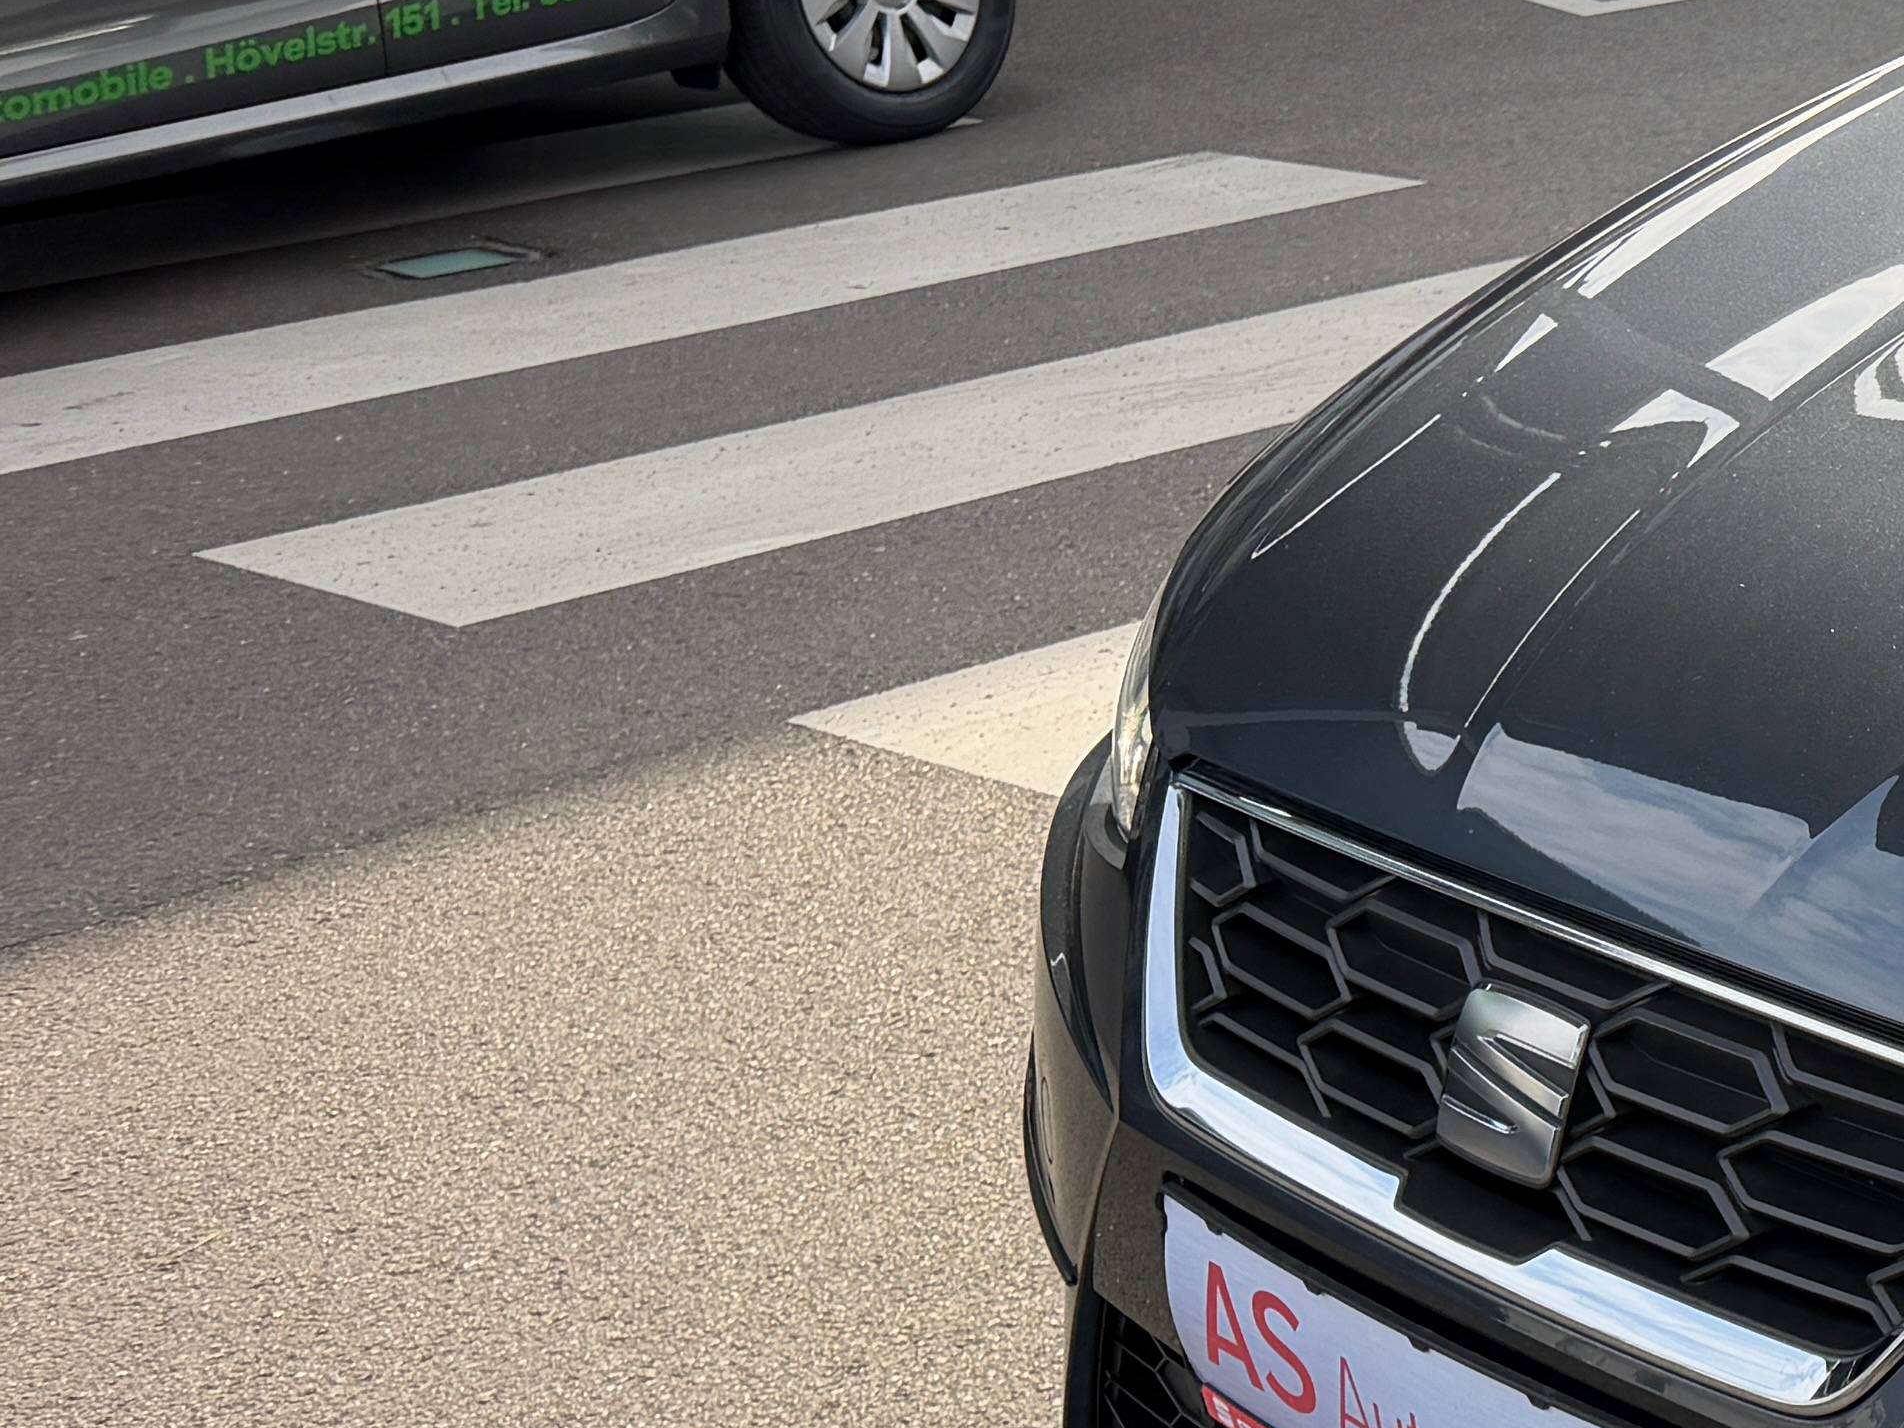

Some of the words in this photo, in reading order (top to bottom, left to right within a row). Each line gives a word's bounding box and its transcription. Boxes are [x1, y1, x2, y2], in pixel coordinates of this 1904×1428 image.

[206, 22, 377, 79] Hövelstr.
[386, 0, 442, 39] 151
[1207, 1259, 1317, 1415] AS
